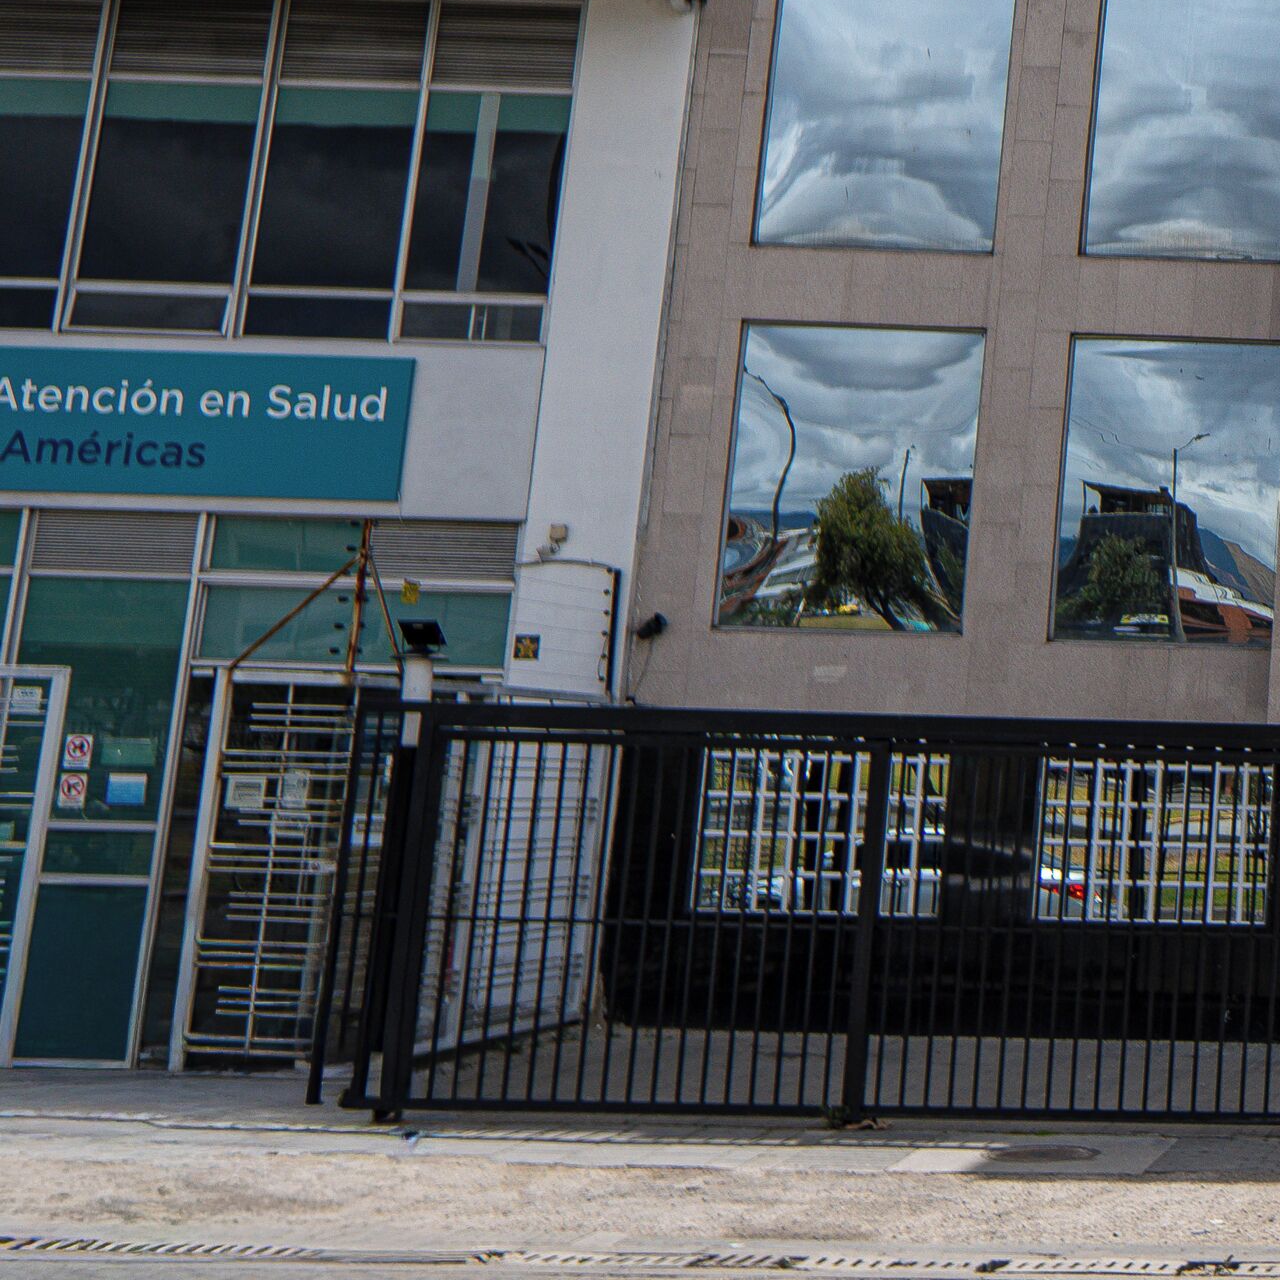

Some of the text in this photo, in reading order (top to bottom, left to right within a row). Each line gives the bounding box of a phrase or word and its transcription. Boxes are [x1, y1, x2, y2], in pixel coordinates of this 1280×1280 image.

[0, 376, 388, 421] Atención en Salud
[0, 429, 207, 468] Américas
